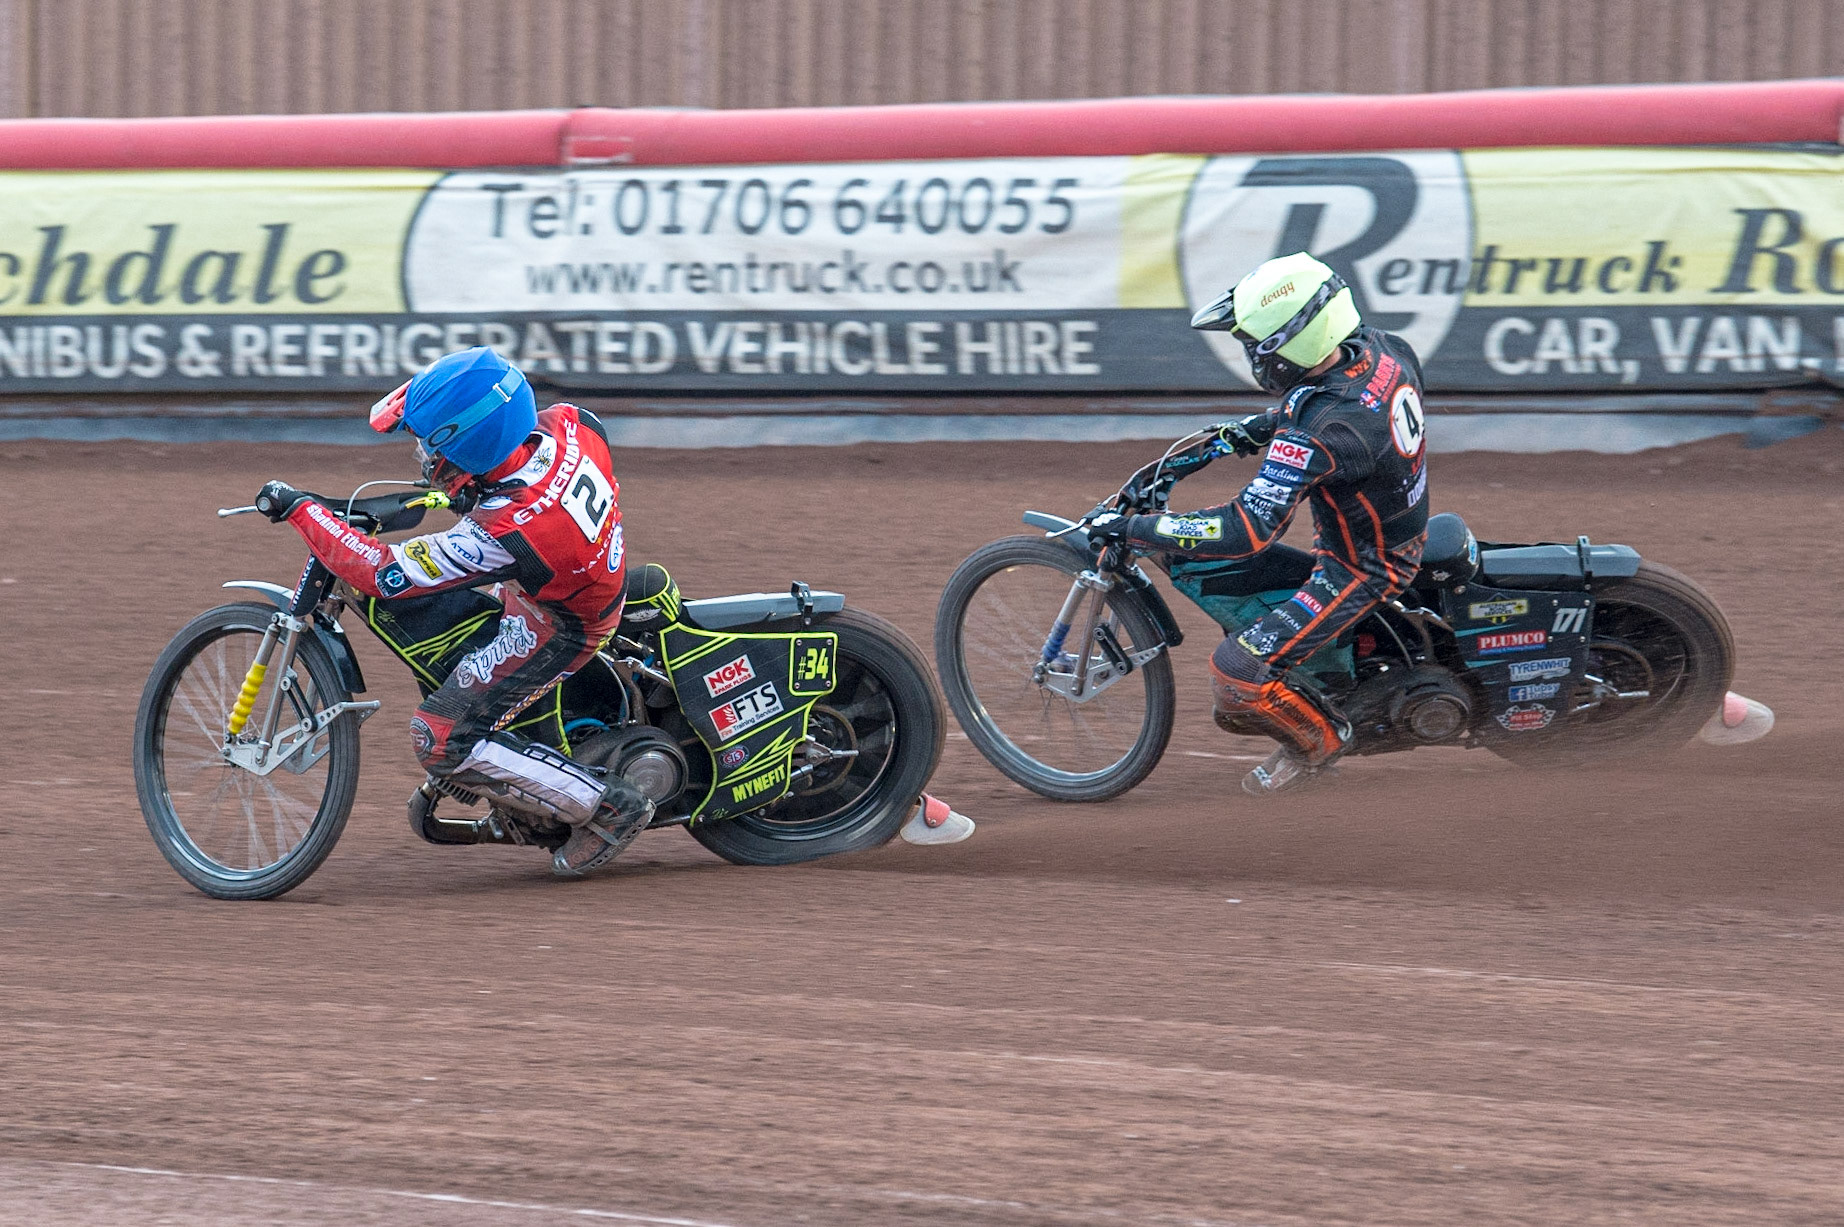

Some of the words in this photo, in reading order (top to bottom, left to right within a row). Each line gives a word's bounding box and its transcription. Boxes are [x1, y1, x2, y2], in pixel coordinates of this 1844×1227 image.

[480, 178, 596, 239] Tel:
[612, 177, 814, 236] 01706
[833, 177, 1083, 236] 640055
[525, 248, 1025, 295] www.rentruck.co.uk
[1260, 281, 1295, 308] dougy
[176, 322, 220, 378] &
[686, 318, 948, 377] VEHICLE
[955, 318, 1102, 377] HIRE
[1483, 316, 1641, 385] CAR,
[1401, 397, 1421, 440] 4
[1271, 442, 1309, 463] NGK
[570, 473, 608, 529] 2
[306, 503, 345, 540] Shannon
[1480, 632, 1545, 649] PLUMCO
[707, 658, 749, 690] NGK
[714, 682, 733, 695] SPARK
[733, 673, 752, 686] PLUGS
[731, 683, 777, 721] FTS
[733, 717, 756, 731] Training
[755, 705, 780, 719] Services
[732, 763, 786, 804] MYNEFIT
